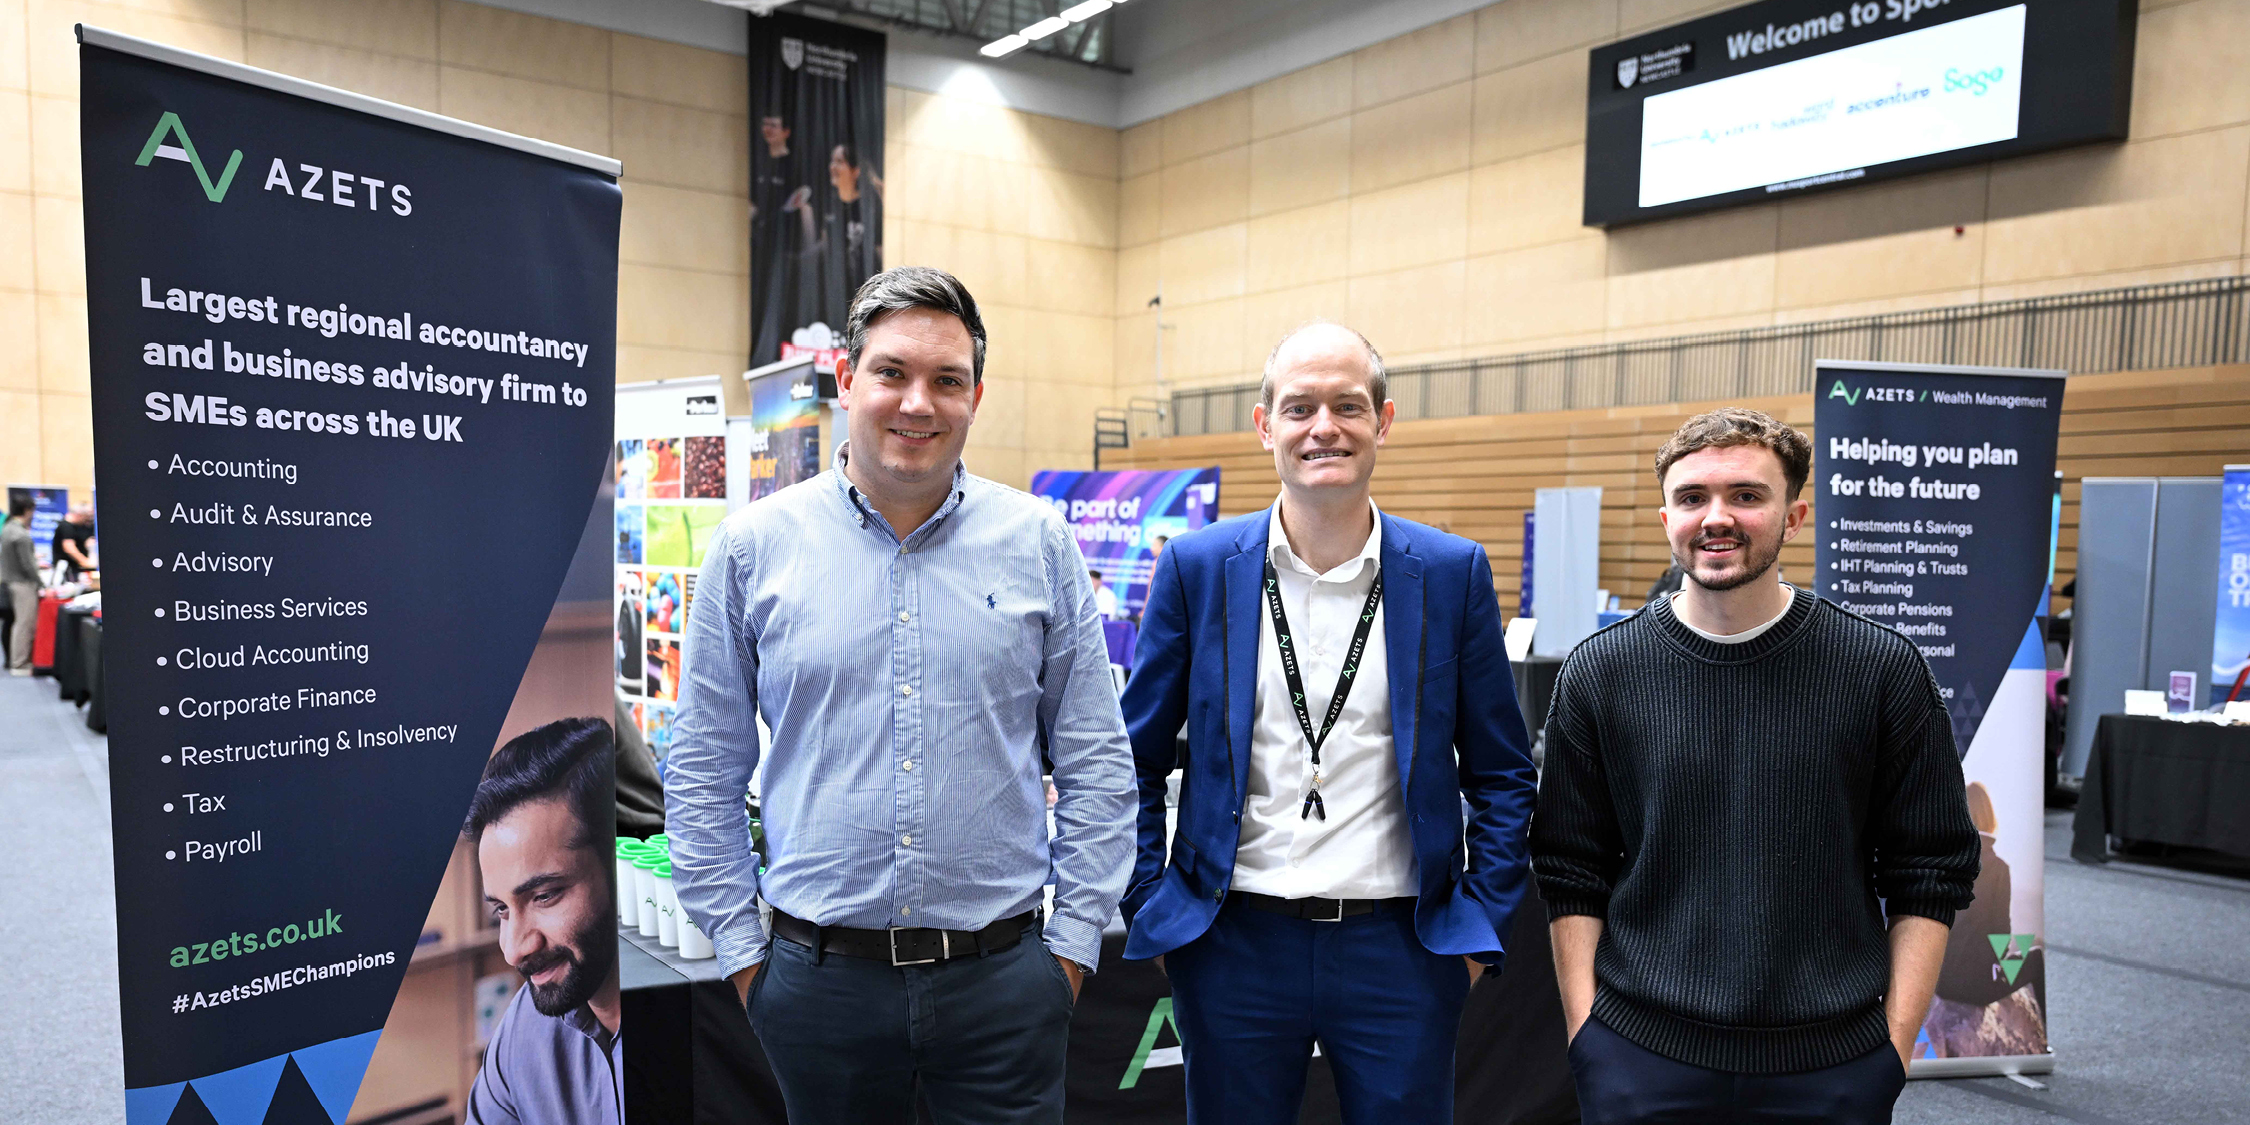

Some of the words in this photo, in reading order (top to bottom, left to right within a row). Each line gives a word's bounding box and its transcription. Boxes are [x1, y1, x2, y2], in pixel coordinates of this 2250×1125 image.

[1726, 12, 1845, 60] Welcome
[1850, 2, 1880, 27] to
[265, 158, 412, 216] AZETS
[141, 278, 278, 323] Largest
[288, 304, 411, 340] regional
[419, 323, 588, 367] accountancy
[143, 339, 213, 370] and
[224, 341, 364, 385] business
[373, 362, 494, 404] advisory
[501, 373, 555, 403] firm
[562, 382, 587, 406] to
[1866, 388, 1914, 402] AZETS
[1933, 391, 1972, 404] Wealth
[1976, 392, 2046, 409] Management
[146, 392, 247, 426] SMEs
[256, 408, 359, 434] across
[366, 410, 415, 438] the
[423, 415, 463, 442] UK
[750, 453, 778, 479] arker
[1830, 437, 1917, 467] Helping
[1922, 446, 1963, 467] you
[1969, 442, 2018, 469] plan
[168, 454, 297, 484] Accounting
[1830, 473, 1864, 495] for
[1868, 476, 1904, 498] the
[1909, 476, 1980, 500] future
[170, 503, 235, 524] Audit
[243, 504, 258, 524] &
[265, 505, 372, 527] Assurance
[1071, 497, 1117, 520] part
[1118, 497, 1141, 519] of
[1069, 520, 1141, 546] mething
[1840, 517, 1910, 533] Investments
[1913, 520, 1923, 533] &
[1926, 520, 1973, 537] Savings
[1841, 538, 1902, 553] Retirement
[1906, 540, 1958, 557] Planning
[173, 551, 273, 576] Advisory
[1841, 559, 1861, 572] IHT
[1864, 560, 1914, 577] Planning
[1917, 561, 1927, 574] &
[1930, 561, 1968, 575] Trusts
[1369, 583, 1381, 608] AZETS
[1840, 579, 1860, 593] Tax
[1863, 581, 1913, 598] Planning
[175, 600, 275, 621] Business
[282, 597, 367, 618] Services
[1271, 595, 1282, 620] AZETS
[1840, 601, 1895, 616] Corporate
[1898, 602, 1952, 616] Pensions
[1895, 622, 1946, 636] Benefits
[177, 645, 244, 669] Cloud
[252, 641, 368, 665] Accounting
[1284, 650, 1295, 676] AZETS
[1350, 637, 1363, 663] AZETS
[1918, 643, 1955, 657] rsonal
[179, 693, 290, 720] Corporate
[298, 688, 376, 708] Finance
[1330, 694, 1343, 719] AZETS
[1298, 709, 1311, 734] AZETS
[182, 735, 329, 766] Restructuring
[337, 731, 351, 750] &
[358, 725, 457, 747] Insolvency
[182, 793, 225, 814] Tax
[186, 830, 261, 862] Payroll
[169, 908, 343, 969] azets.co.uk
[172, 949, 395, 1013] #AzetsSMEChampions
